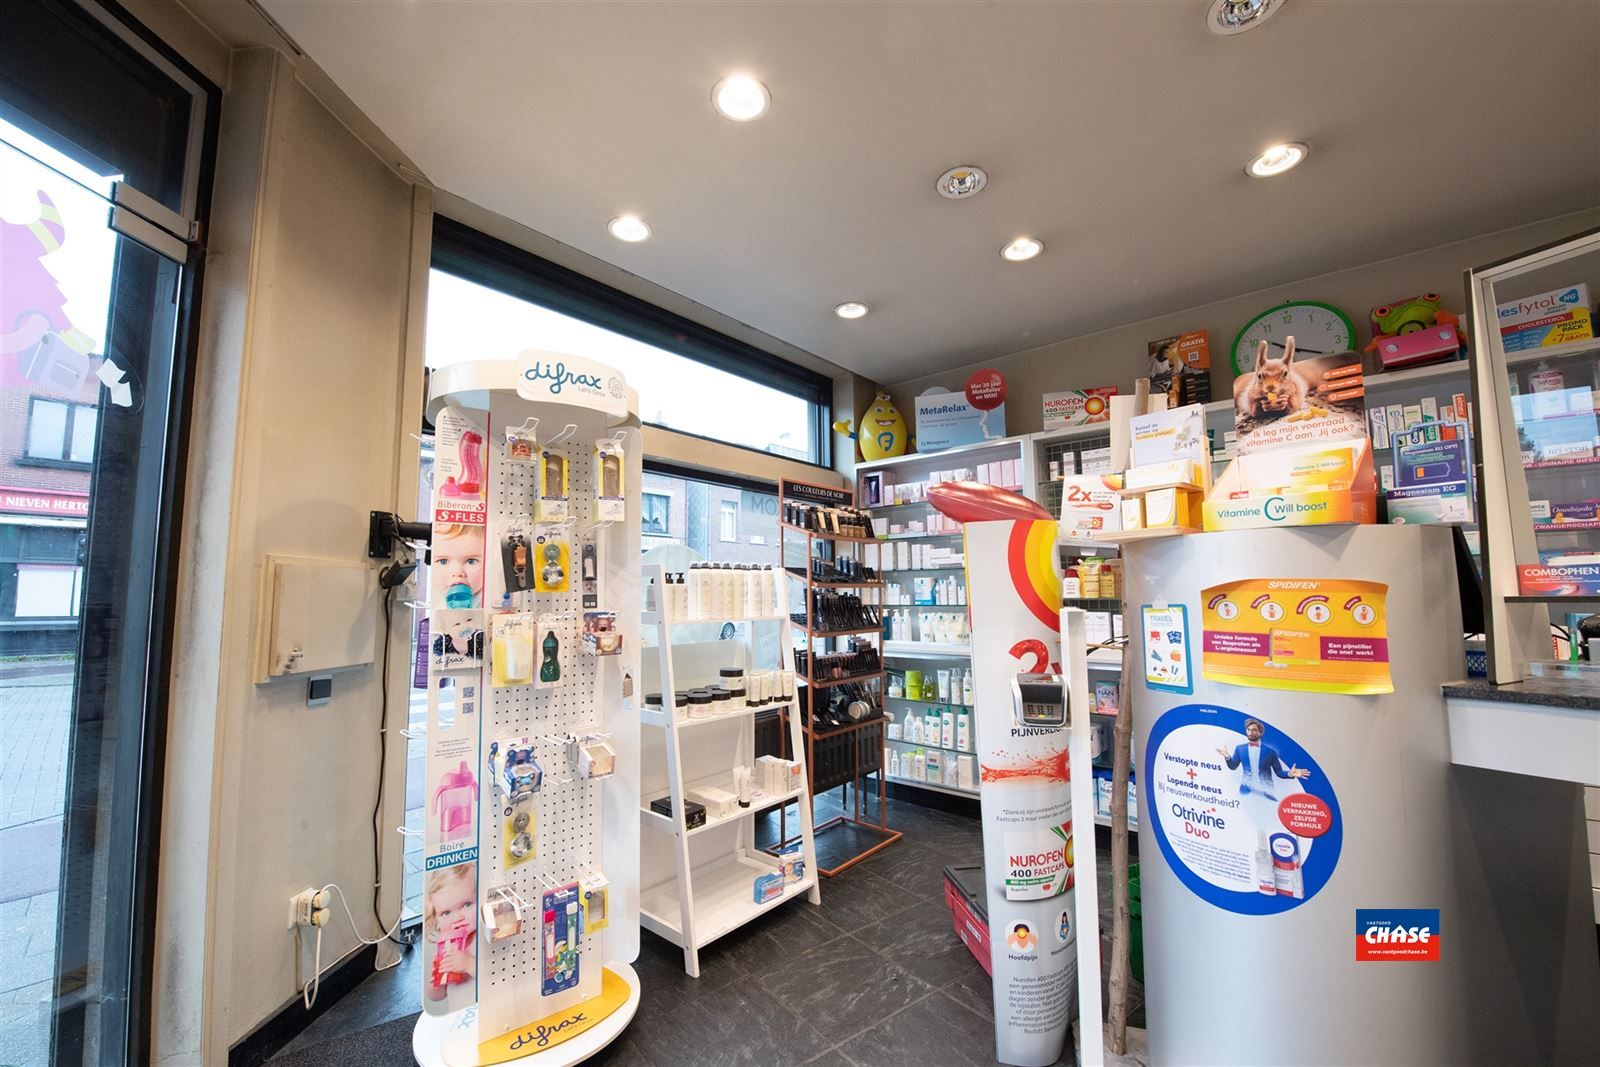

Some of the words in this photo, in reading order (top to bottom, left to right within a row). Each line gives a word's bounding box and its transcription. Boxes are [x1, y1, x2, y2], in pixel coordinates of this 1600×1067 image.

[1282, 314, 1293, 324] 12
[1308, 314, 1313, 323] 1
[1518, 315, 1566, 330] CHOLESTEROL
[1557, 318, 1588, 328] PROMO
[1262, 324, 1272, 333] 11
[1326, 322, 1332, 331] 2
[1562, 324, 1584, 332] PACK
[1180, 338, 1204, 348] GRATIS
[1250, 339, 1258, 348] 10
[1335, 334, 1342, 344] 3
[1244, 354, 1250, 364] 9
[524, 362, 602, 394] difrax
[1044, 398, 1084, 408] NUROFEN
[920, 404, 967, 416] MetaRelax
[1264, 428, 1277, 439] leg
[1280, 424, 1299, 435] mijn
[1302, 416, 1345, 430] voorraad
[1246, 434, 1283, 448] vitamine
[1286, 433, 1292, 441] C
[1331, 424, 1355, 434] ook?
[1538, 460, 1574, 468] URINAIRE
[1068, 485, 1092, 502] 2x
[1394, 488, 1441, 496] Magnesium
[6, 496, 50, 508] NIEVEN
[1296, 502, 1328, 512] boost
[1217, 507, 1260, 518] Vitamine
[1264, 496, 1286, 522] C
[1274, 503, 1294, 514] Will
[1524, 566, 1600, 576] COMBOPHEN
[1268, 581, 1318, 590] SPIDIFEN
[1272, 629, 1310, 638] SPIDIFEN
[1343, 643, 1372, 651] pijnstiller
[436, 656, 465, 668] dfrax
[1164, 752, 1198, 767] Verstopte
[1200, 762, 1222, 771] neus
[1167, 774, 1199, 790] Lopende
[1200, 784, 1222, 794] neus
[1166, 784, 1240, 809] neusverkoudheid?
[1172, 803, 1225, 830] Otrivine
[1282, 808, 1327, 818] VERPAKKING,
[1290, 821, 1322, 829] FORMULE
[1185, 822, 1210, 840] Duo
[440, 841, 464, 852] Boire
[426, 849, 478, 870] DRINKEN
[1010, 848, 1064, 868] NUROFEN
[1010, 870, 1032, 878] 400
[1034, 862, 1065, 876] FASTCAPS
[1008, 954, 1038, 962] Hoofdpijn
[510, 1012, 588, 1050] difrax
